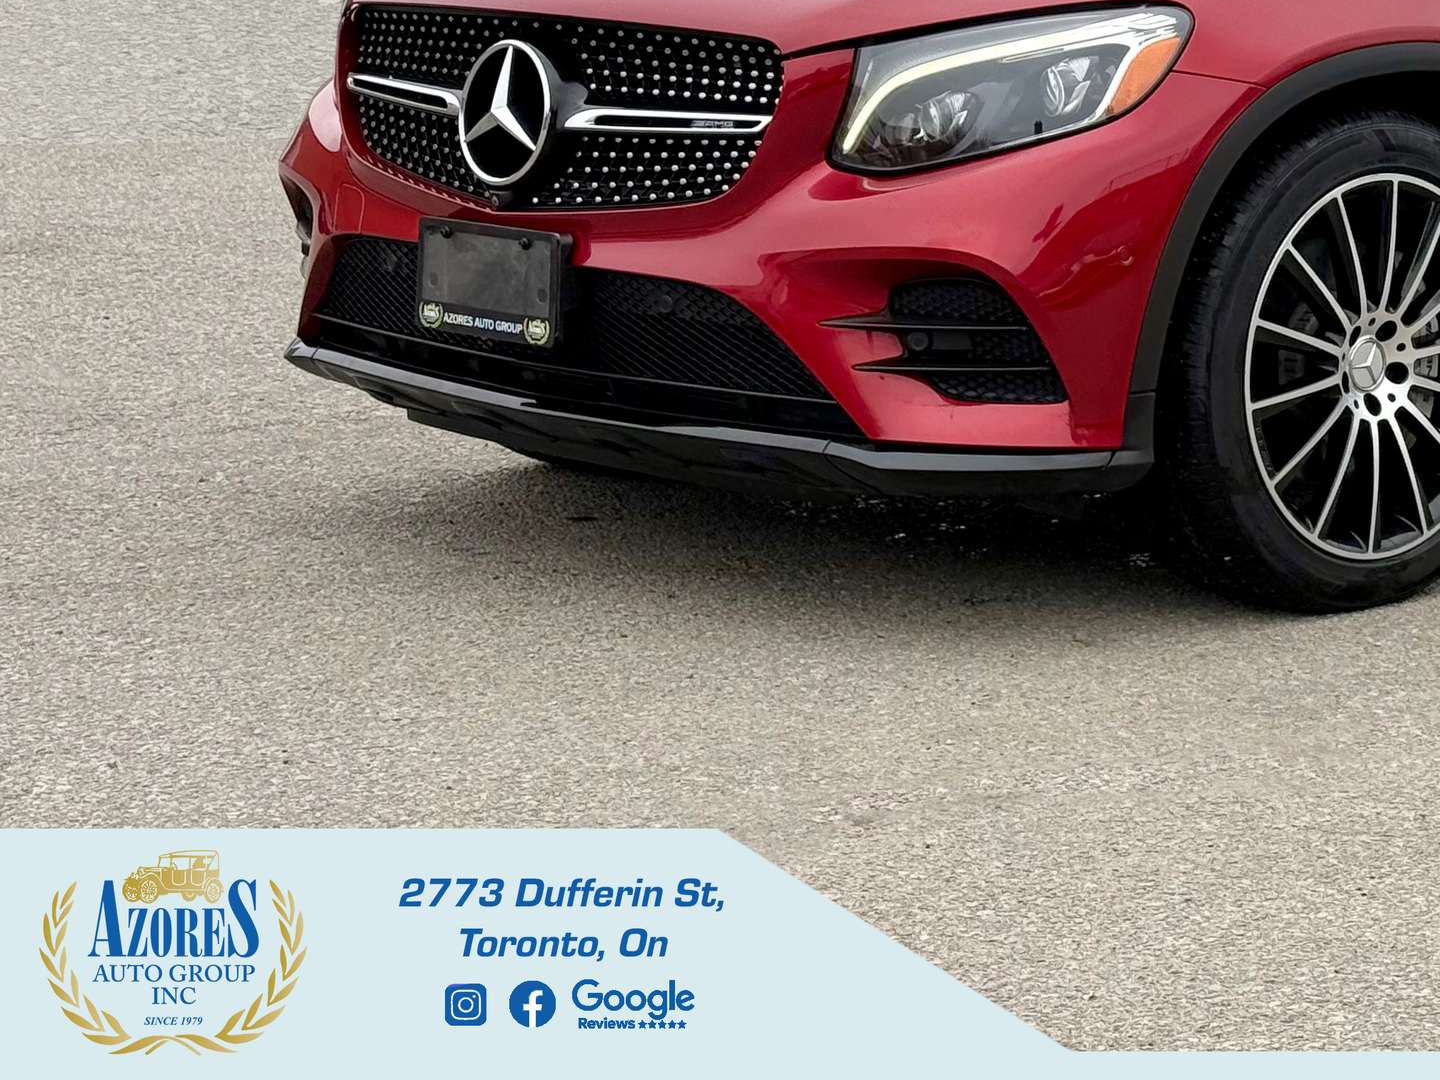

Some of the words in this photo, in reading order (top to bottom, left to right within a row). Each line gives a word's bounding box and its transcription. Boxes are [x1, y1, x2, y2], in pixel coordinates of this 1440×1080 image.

[443, 312, 473, 327] AZORES
[474, 317, 494, 330] AUTO
[495, 321, 523, 334] GROUP
